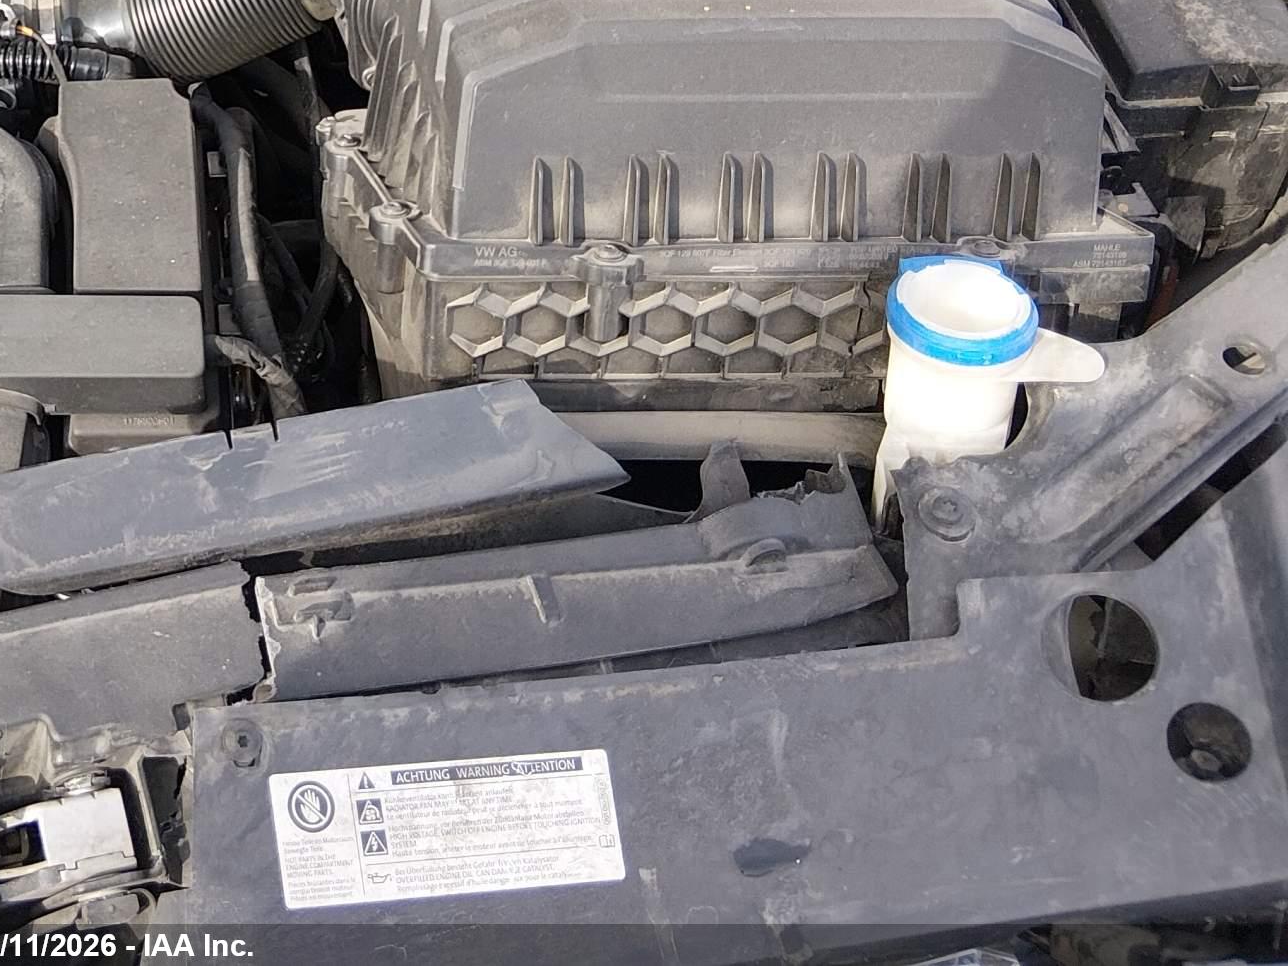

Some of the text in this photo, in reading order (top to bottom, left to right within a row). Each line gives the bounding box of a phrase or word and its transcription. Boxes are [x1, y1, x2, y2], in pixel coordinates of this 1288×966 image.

[474, 246, 495, 257] VW
[498, 247, 518, 257] AG
[394, 768, 450, 783] ACHTUNG
[455, 763, 509, 778] WARNING
